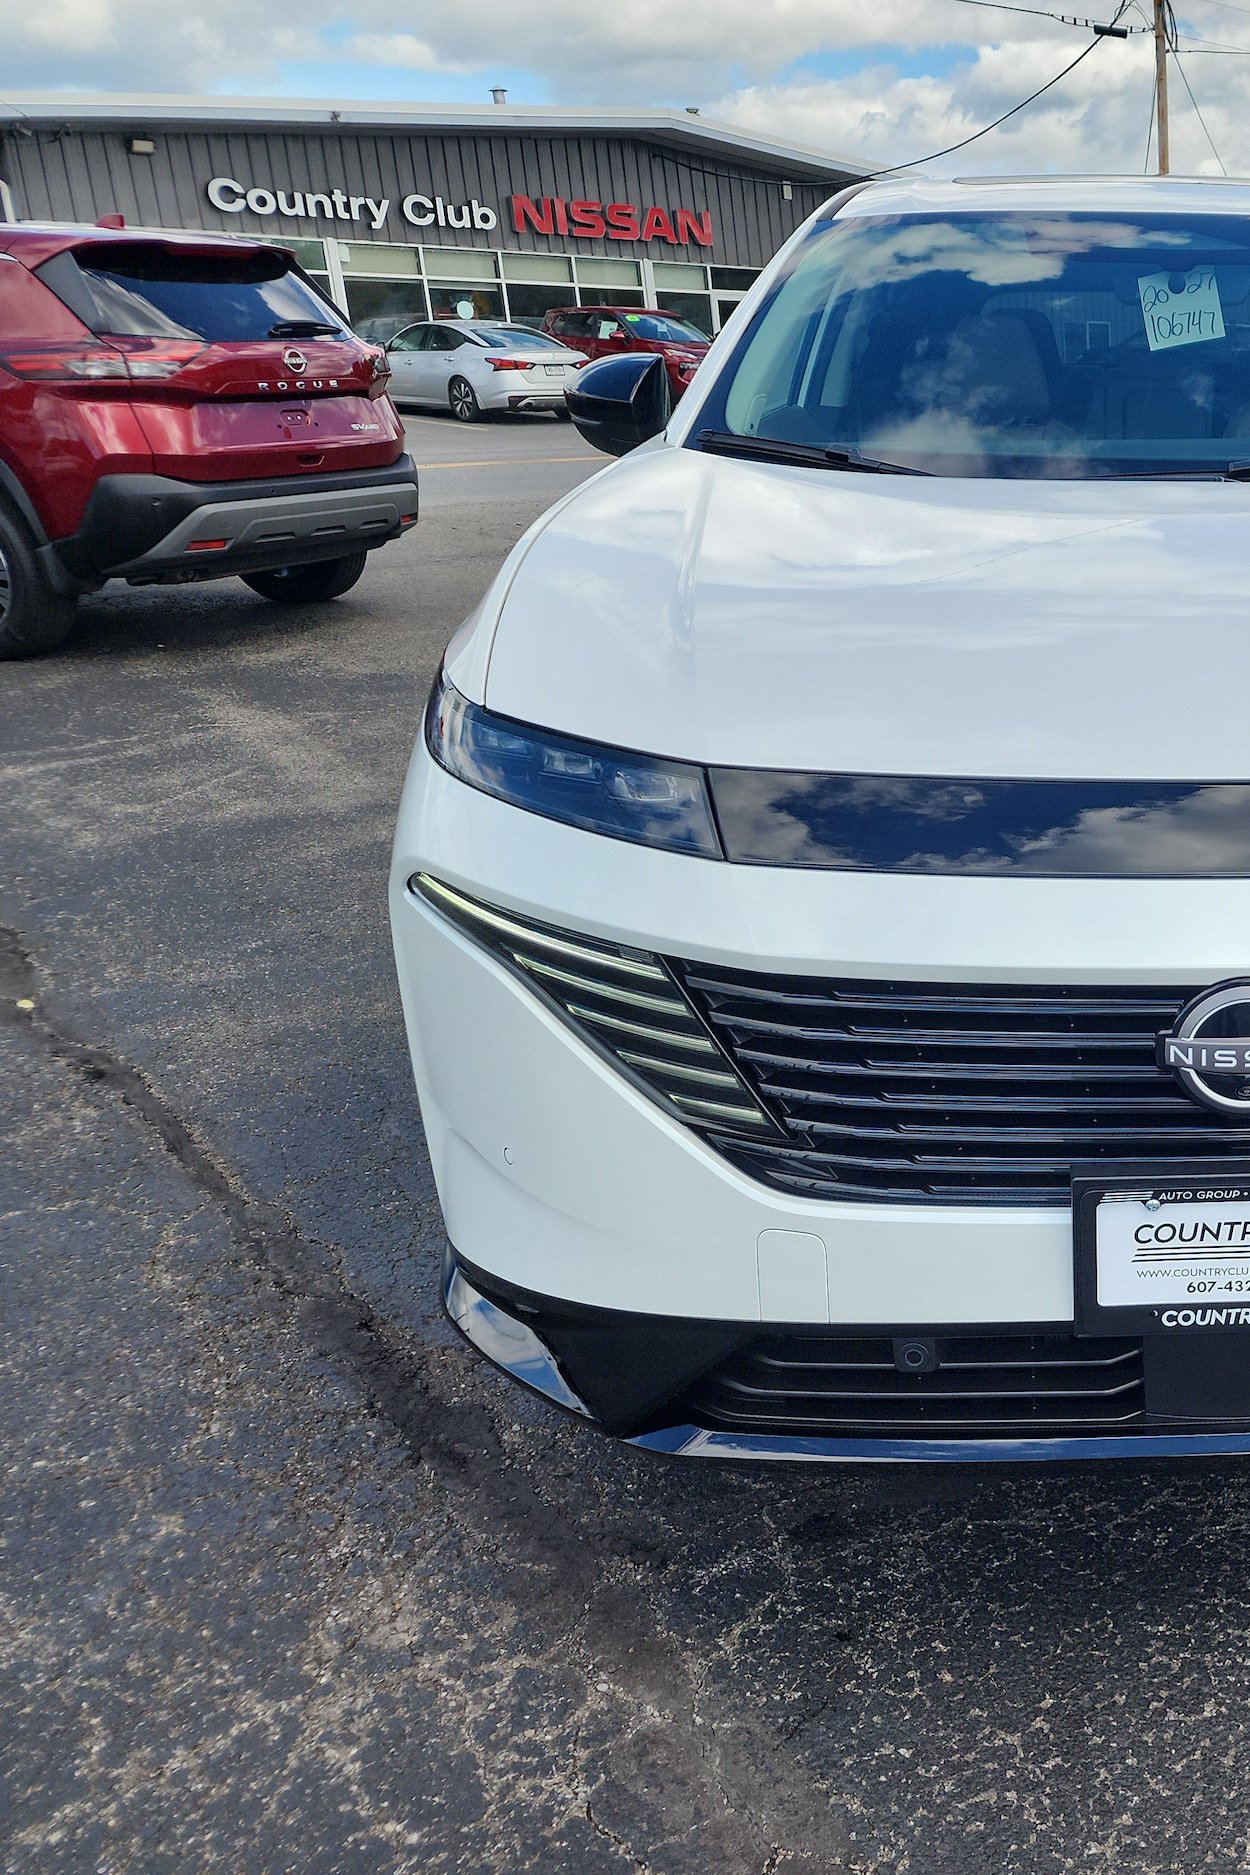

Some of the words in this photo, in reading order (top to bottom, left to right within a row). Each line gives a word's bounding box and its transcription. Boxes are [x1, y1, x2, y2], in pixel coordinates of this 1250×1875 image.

[207, 177, 390, 230] Country
[402, 193, 497, 231] Club
[510, 194, 714, 246] NISSAN
[1143, 286, 1169, 312] 20
[1150, 310, 1215, 343] 106747
[257, 380, 339, 391] ROGUE
[1158, 1190, 1193, 1201] AUTO
[1196, 1189, 1240, 1200] GROUP
